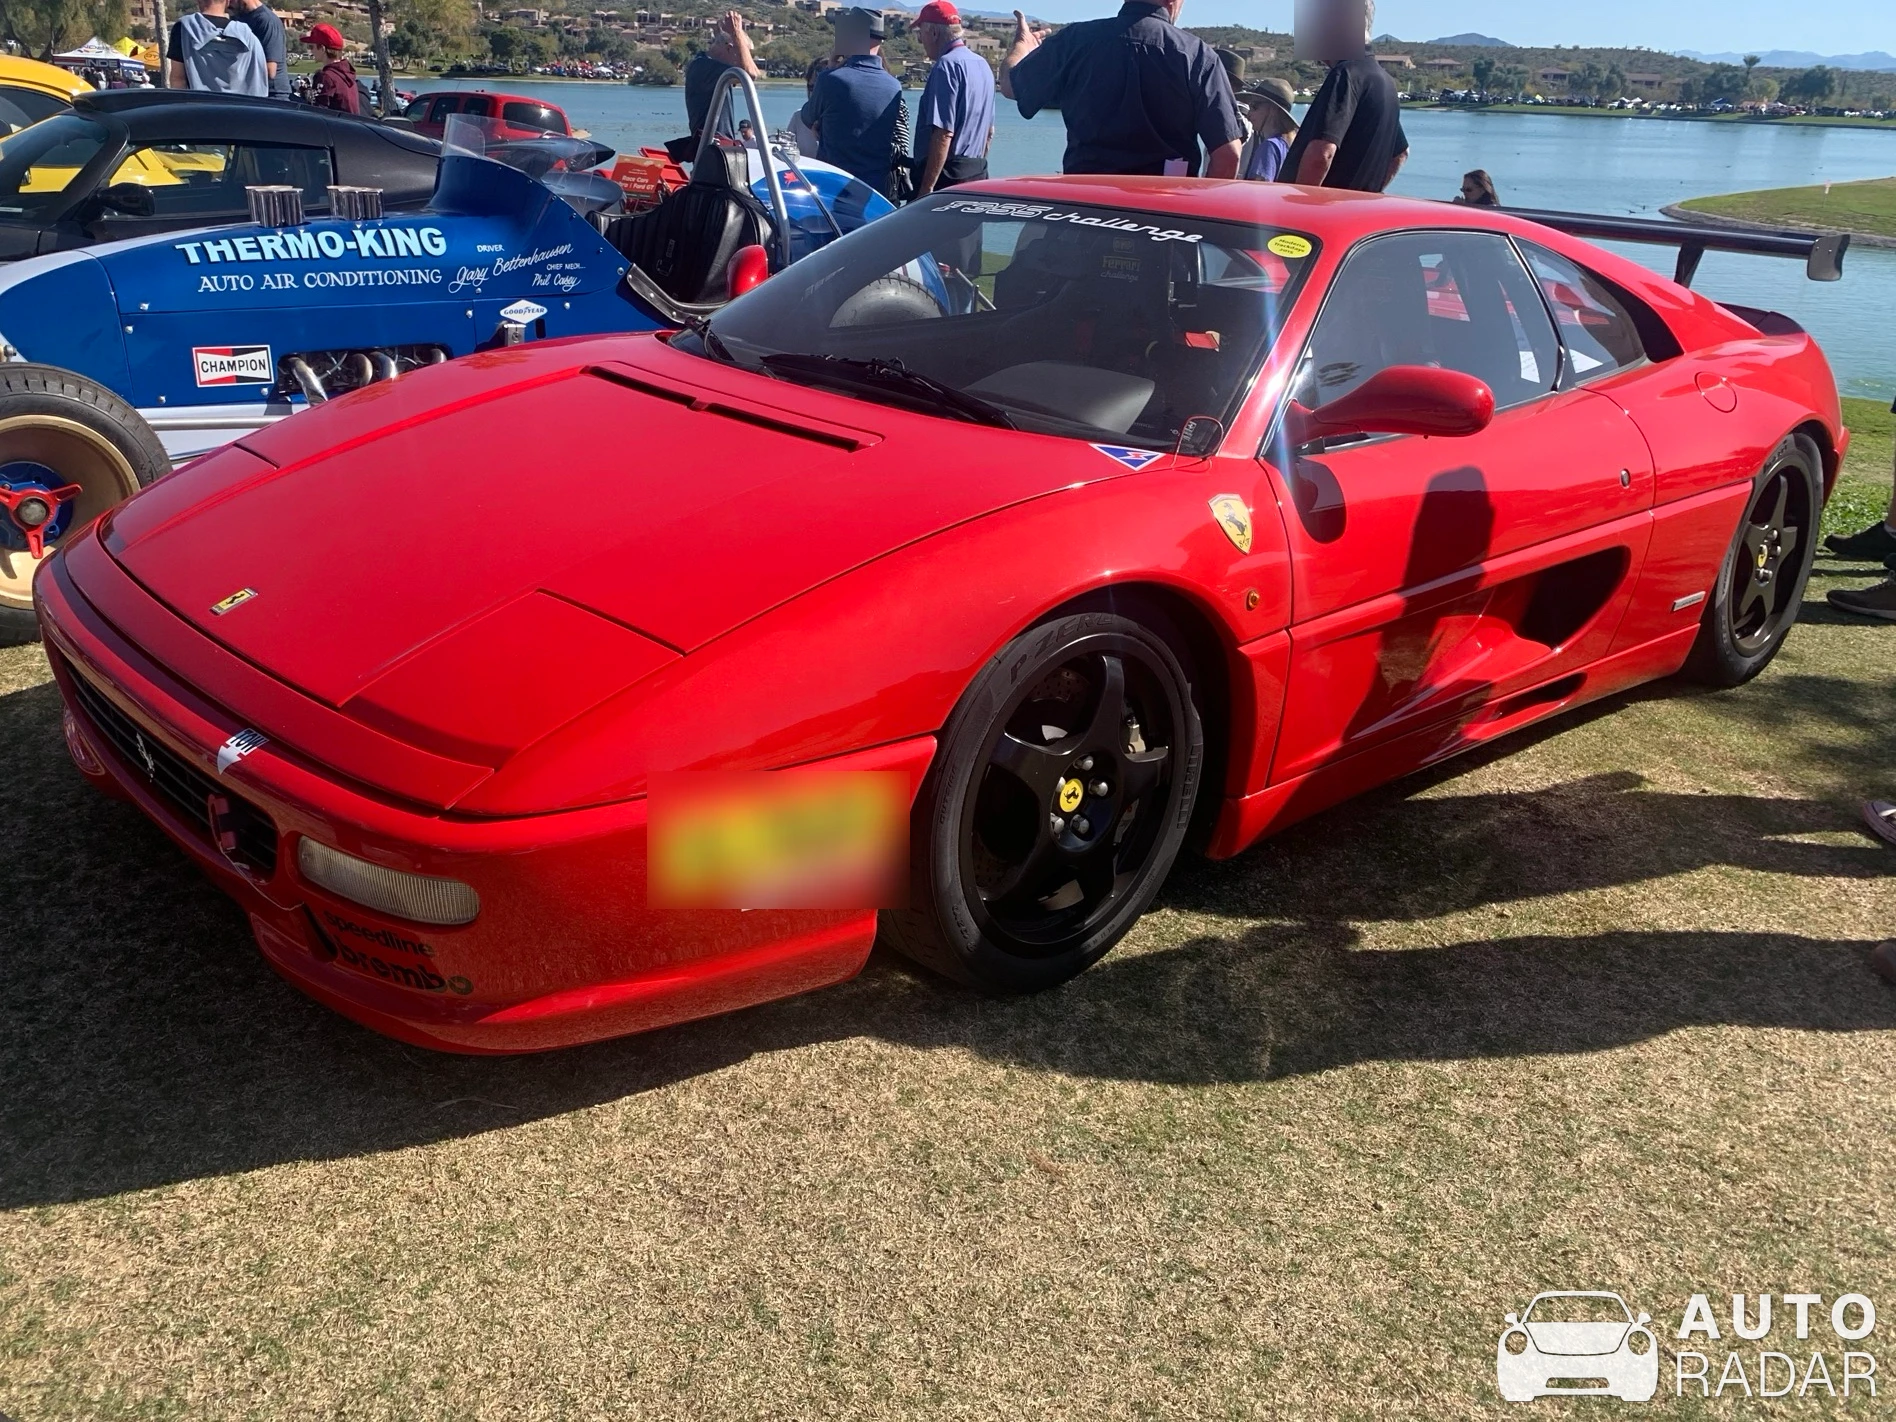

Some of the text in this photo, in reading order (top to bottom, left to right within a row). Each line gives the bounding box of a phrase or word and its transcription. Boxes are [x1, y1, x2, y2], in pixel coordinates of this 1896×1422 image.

[622, 175, 635, 183] Race
[931, 200, 1054, 218] F355
[1042, 212, 1203, 242] challenge
[175, 226, 447, 264] THERMO-KING
[477, 244, 505, 252] DRIVER
[448, 243, 574, 293] Gary Bettenhausen
[547, 263, 563, 271] CHIEF
[198, 269, 442, 293] AUTO AIR CONDITIONING
[532, 273, 581, 292] Phil Casey
[503, 306, 545, 315] GOODYEAR
[201, 359, 266, 373] CHAMPION
[230, 729, 266, 753] TOW
[323, 910, 436, 957] speedline
[333, 934, 474, 995] brembo
